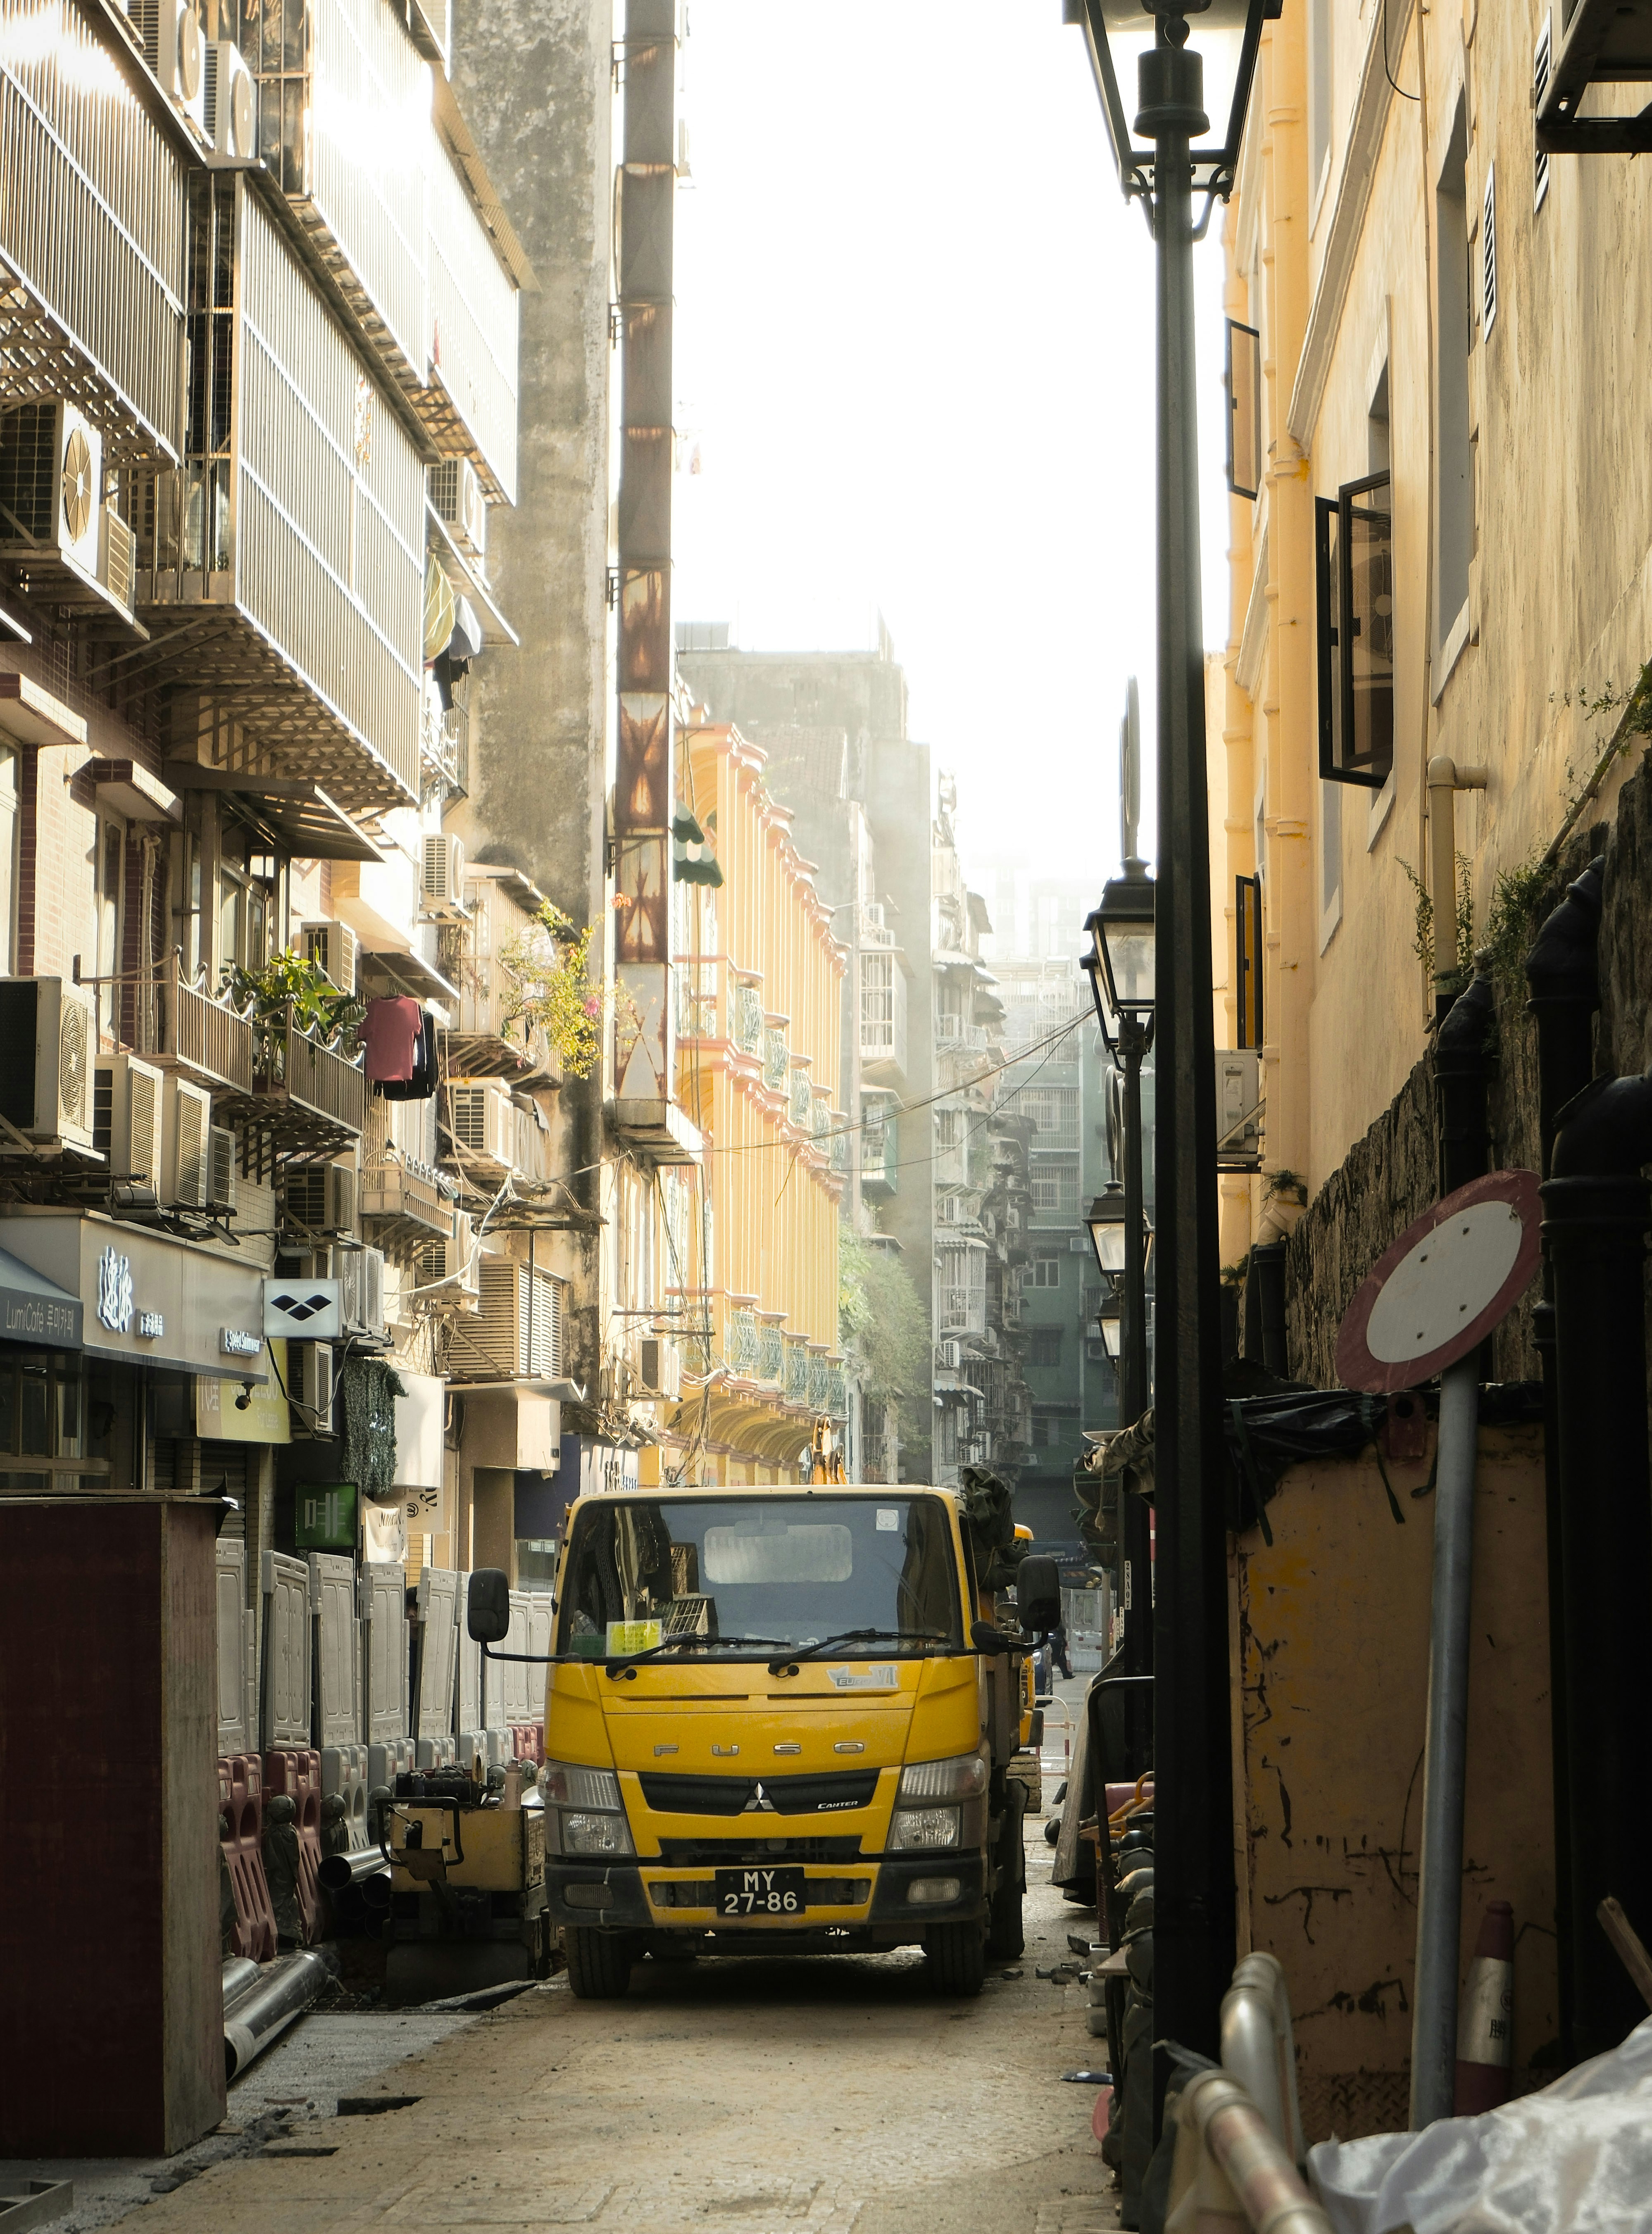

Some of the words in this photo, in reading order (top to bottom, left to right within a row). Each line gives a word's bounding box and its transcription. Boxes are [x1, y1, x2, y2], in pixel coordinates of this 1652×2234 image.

[7, 1300, 44, 1333] LumiCafé
[47, 1304, 74, 1339] 루미카페
[229, 1330, 242, 1351] Speed
[305, 1492, 346, 1538] 啡
[654, 1742, 864, 1756] FUSO
[817, 1800, 859, 1810] CANTER
[744, 1870, 775, 1891] MY
[724, 1891, 797, 1913] 27-86
